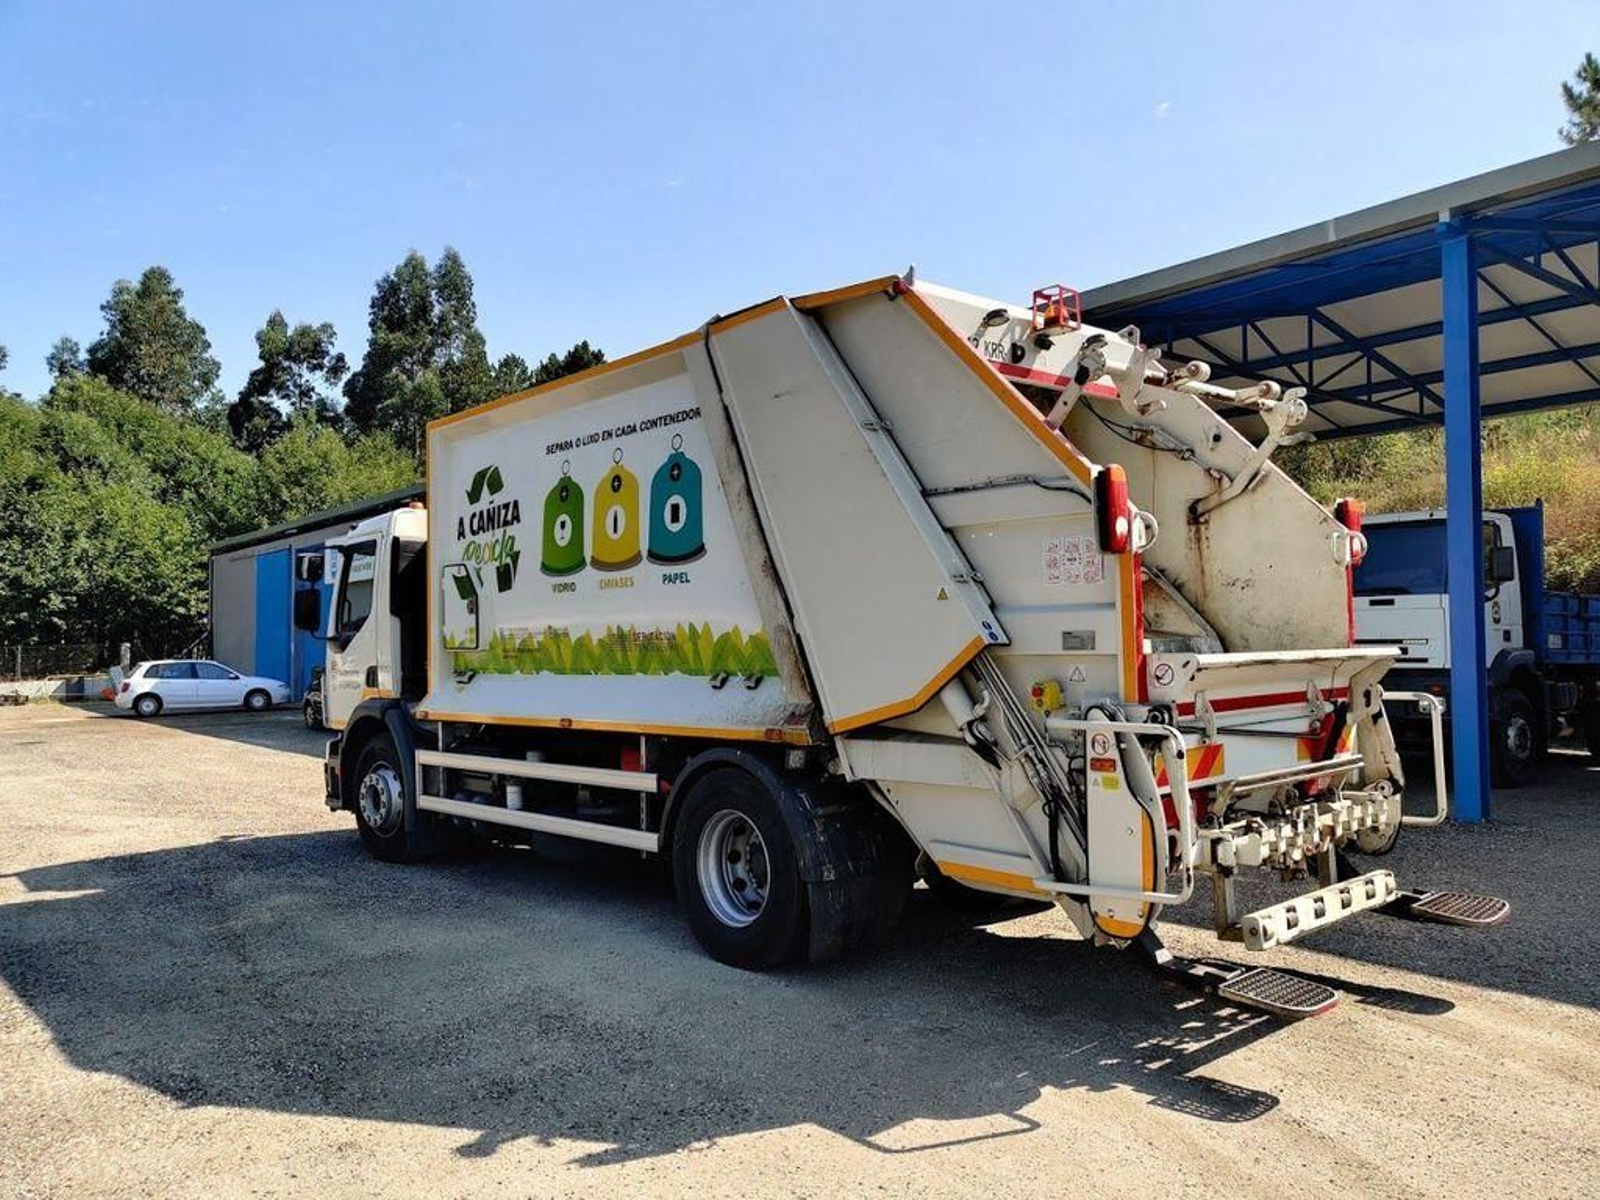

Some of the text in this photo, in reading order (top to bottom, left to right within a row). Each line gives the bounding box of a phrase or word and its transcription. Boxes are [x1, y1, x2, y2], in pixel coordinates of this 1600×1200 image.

[545, 407, 702, 455] SEPARA O LIXO EN CADA CONTENEDOR
[457, 499, 521, 541] A CAÑIZA
[599, 576, 635, 590] ENVASES
[661, 571, 691, 585] PAPEL
[551, 582, 577, 593] VIDRIO
